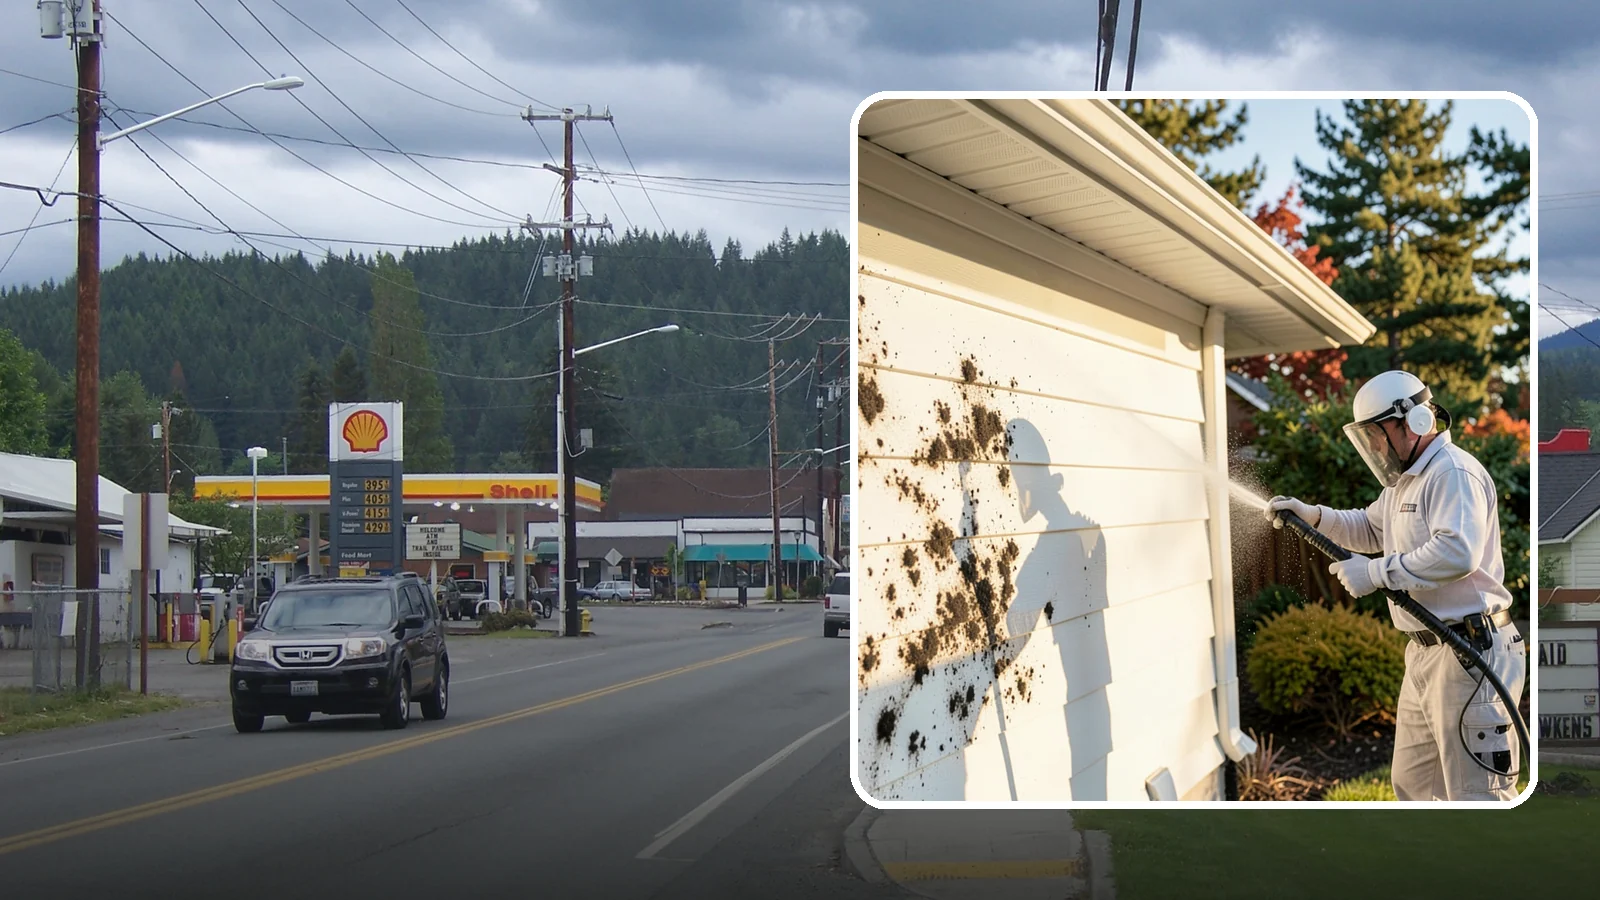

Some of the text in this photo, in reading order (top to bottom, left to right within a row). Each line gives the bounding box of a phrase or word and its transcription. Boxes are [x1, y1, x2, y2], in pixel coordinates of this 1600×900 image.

[365, 480, 384, 490] 395
[490, 484, 547, 498] Shell
[365, 494, 384, 504] 405
[365, 508, 383, 518] 415
[366, 522, 383, 533] 429
